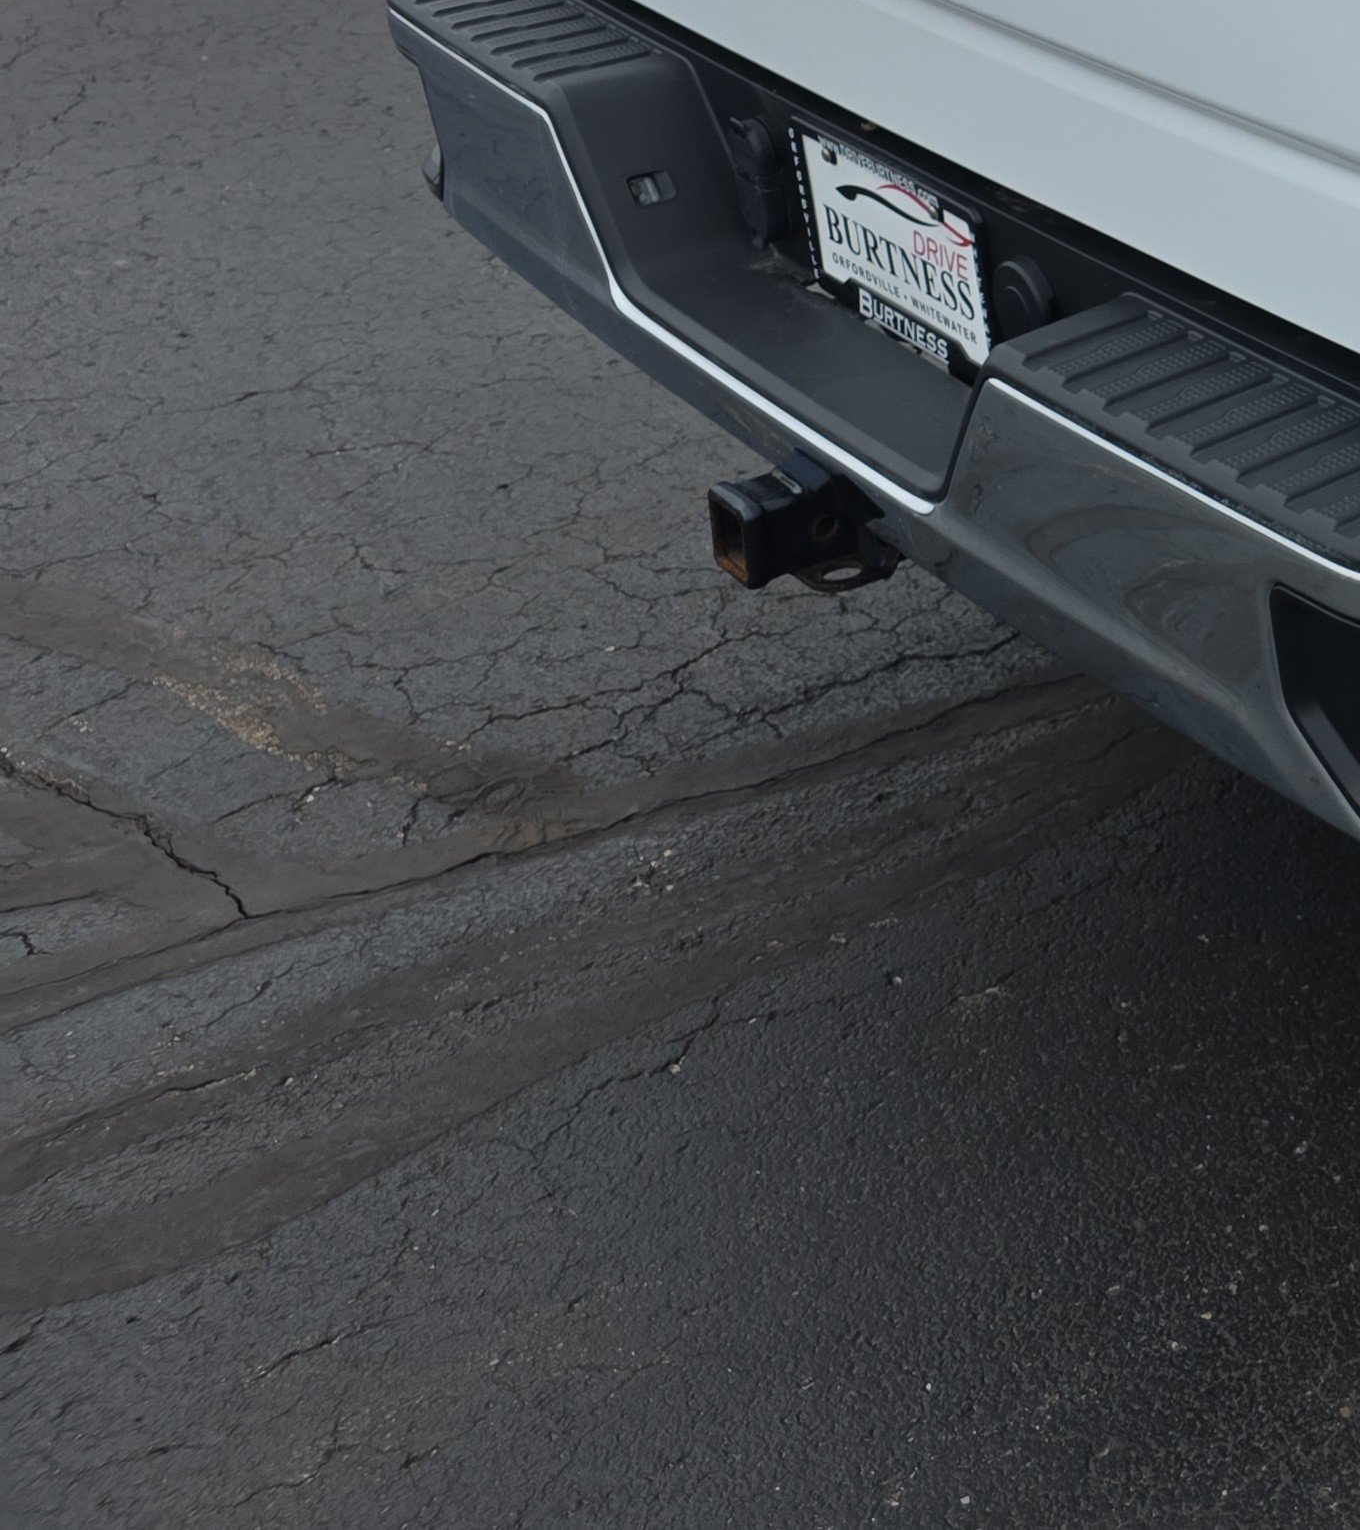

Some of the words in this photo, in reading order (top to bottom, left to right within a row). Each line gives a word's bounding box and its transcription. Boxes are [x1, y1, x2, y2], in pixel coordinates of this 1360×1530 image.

[822, 203, 976, 322] BURTNESS
[912, 229, 968, 282] DRIVE
[831, 251, 901, 300] ORFORDVILLE
[911, 296, 979, 345] WHITEWATER
[858, 291, 950, 360] BURTNESS
